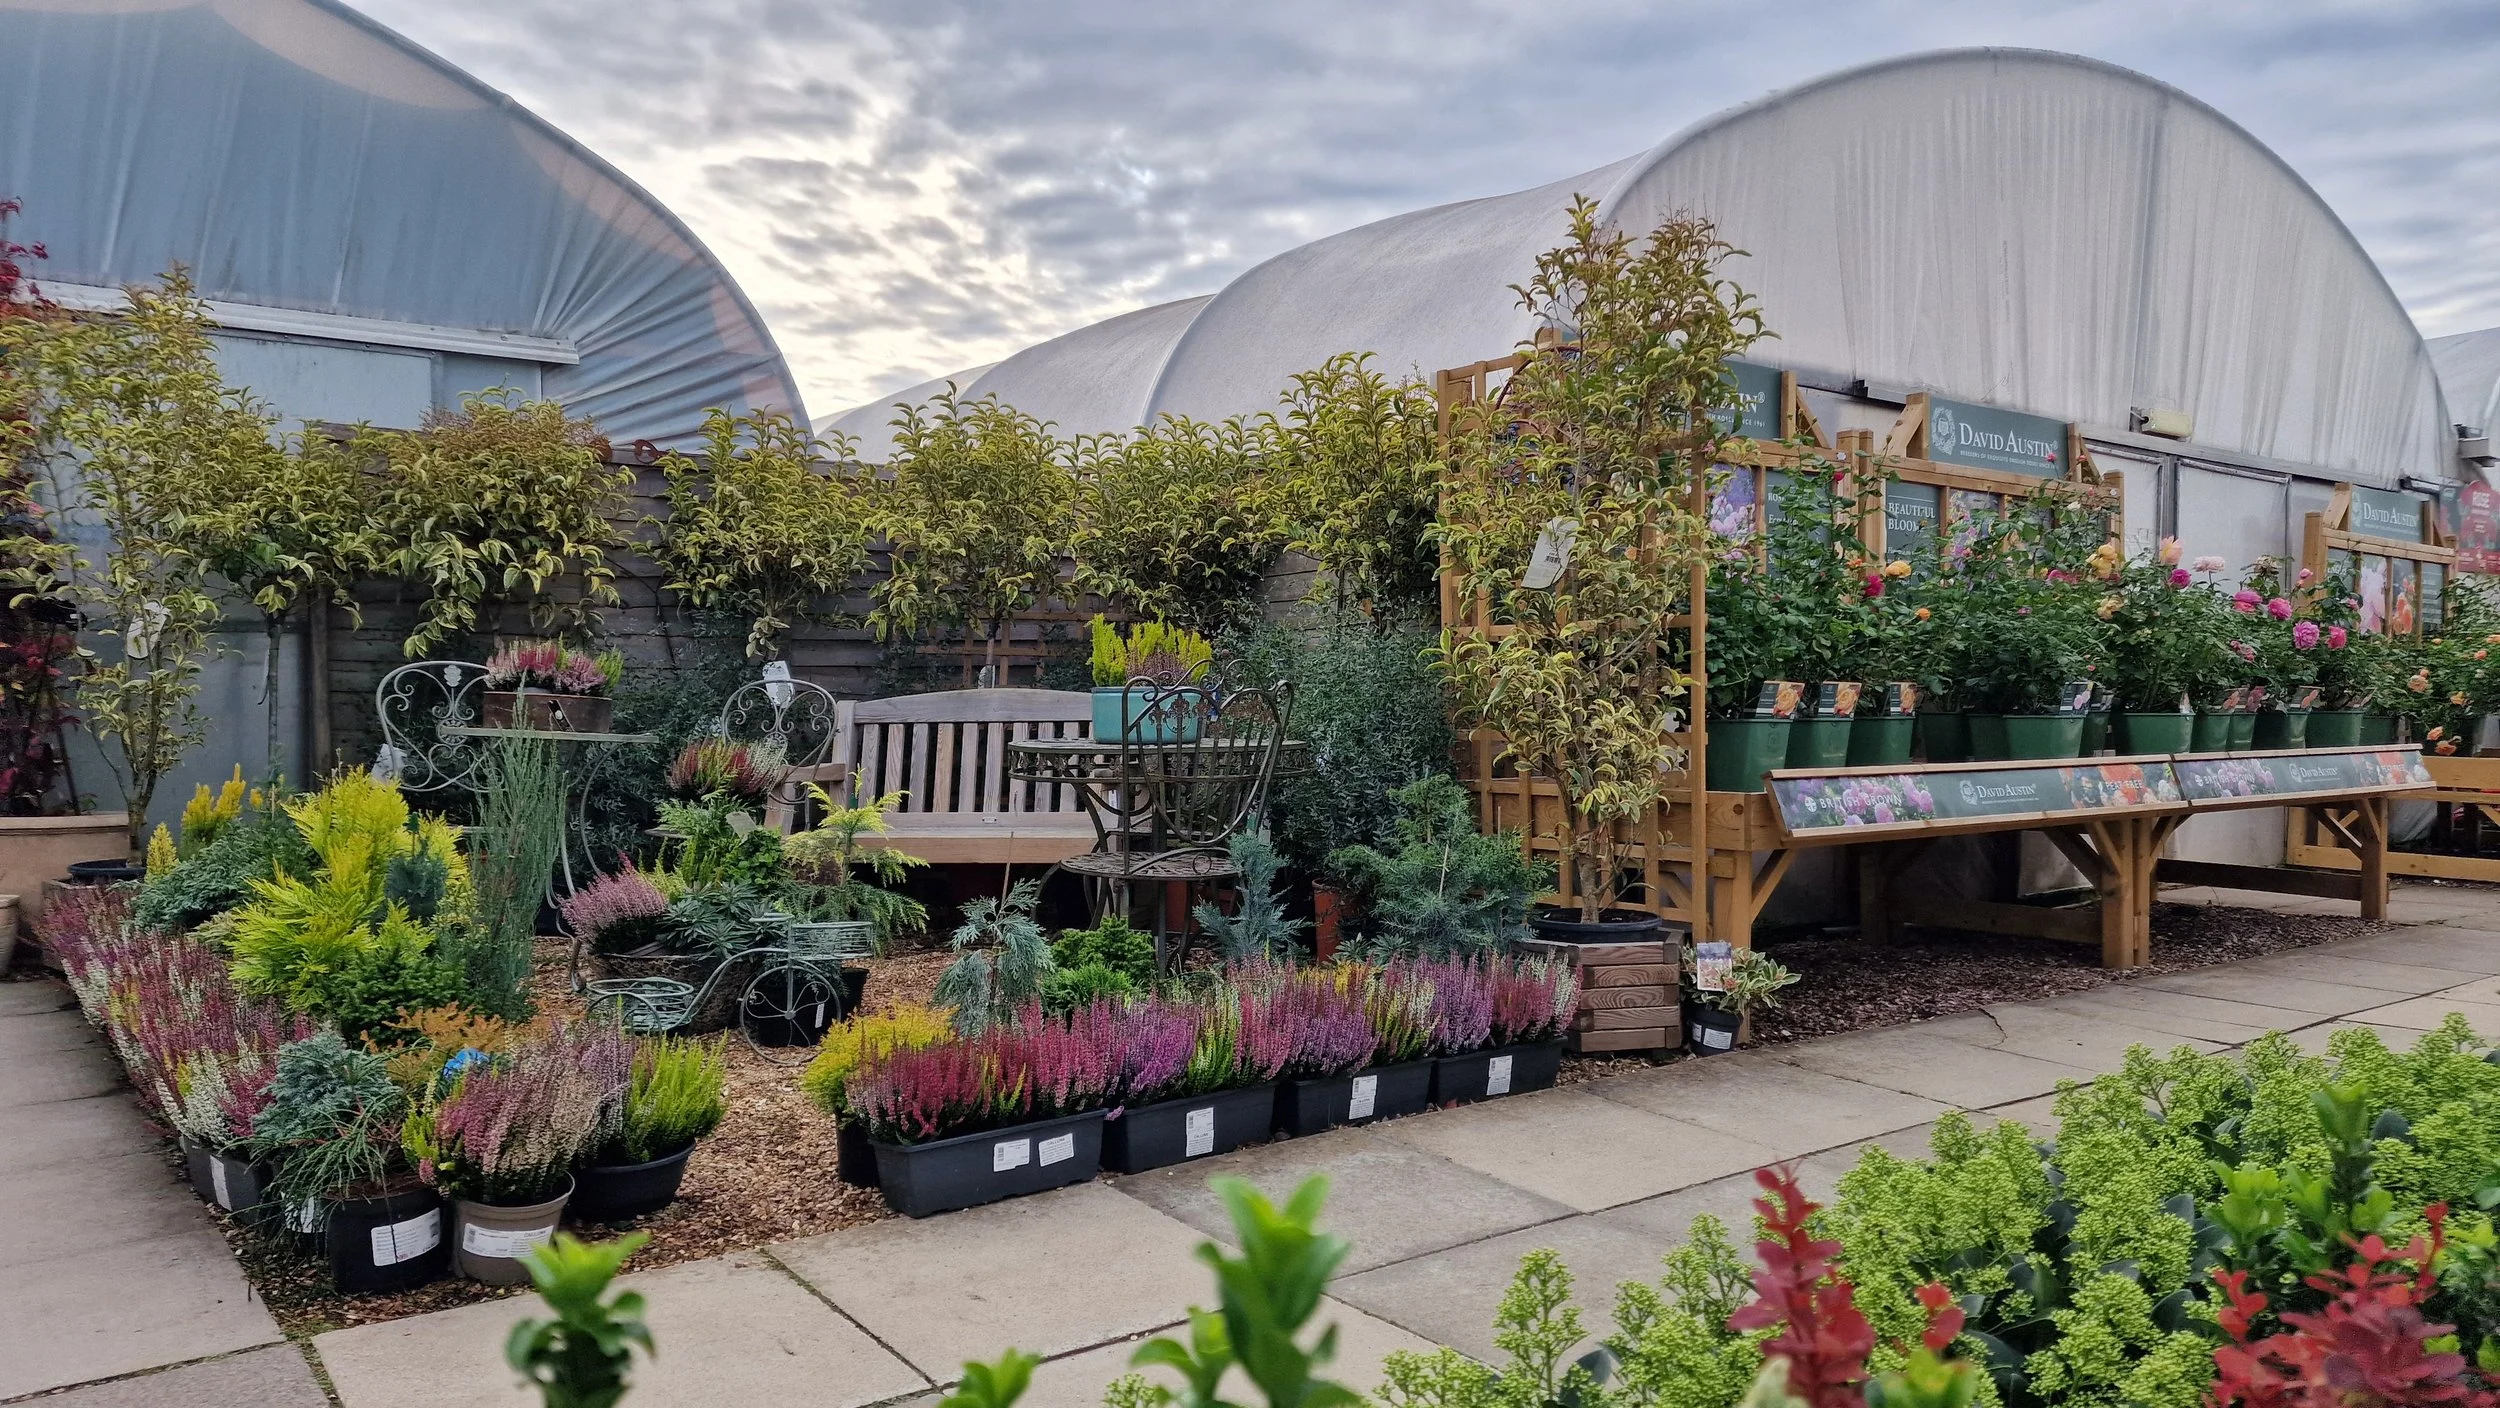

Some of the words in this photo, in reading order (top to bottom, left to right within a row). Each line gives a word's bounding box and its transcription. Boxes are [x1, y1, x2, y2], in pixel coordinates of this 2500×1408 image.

[1959, 422, 2004, 450] DAVID
[2363, 503, 2390, 523] DAVID
[1864, 793, 1903, 807] GROWN
[1976, 785, 2005, 798] DAVID
